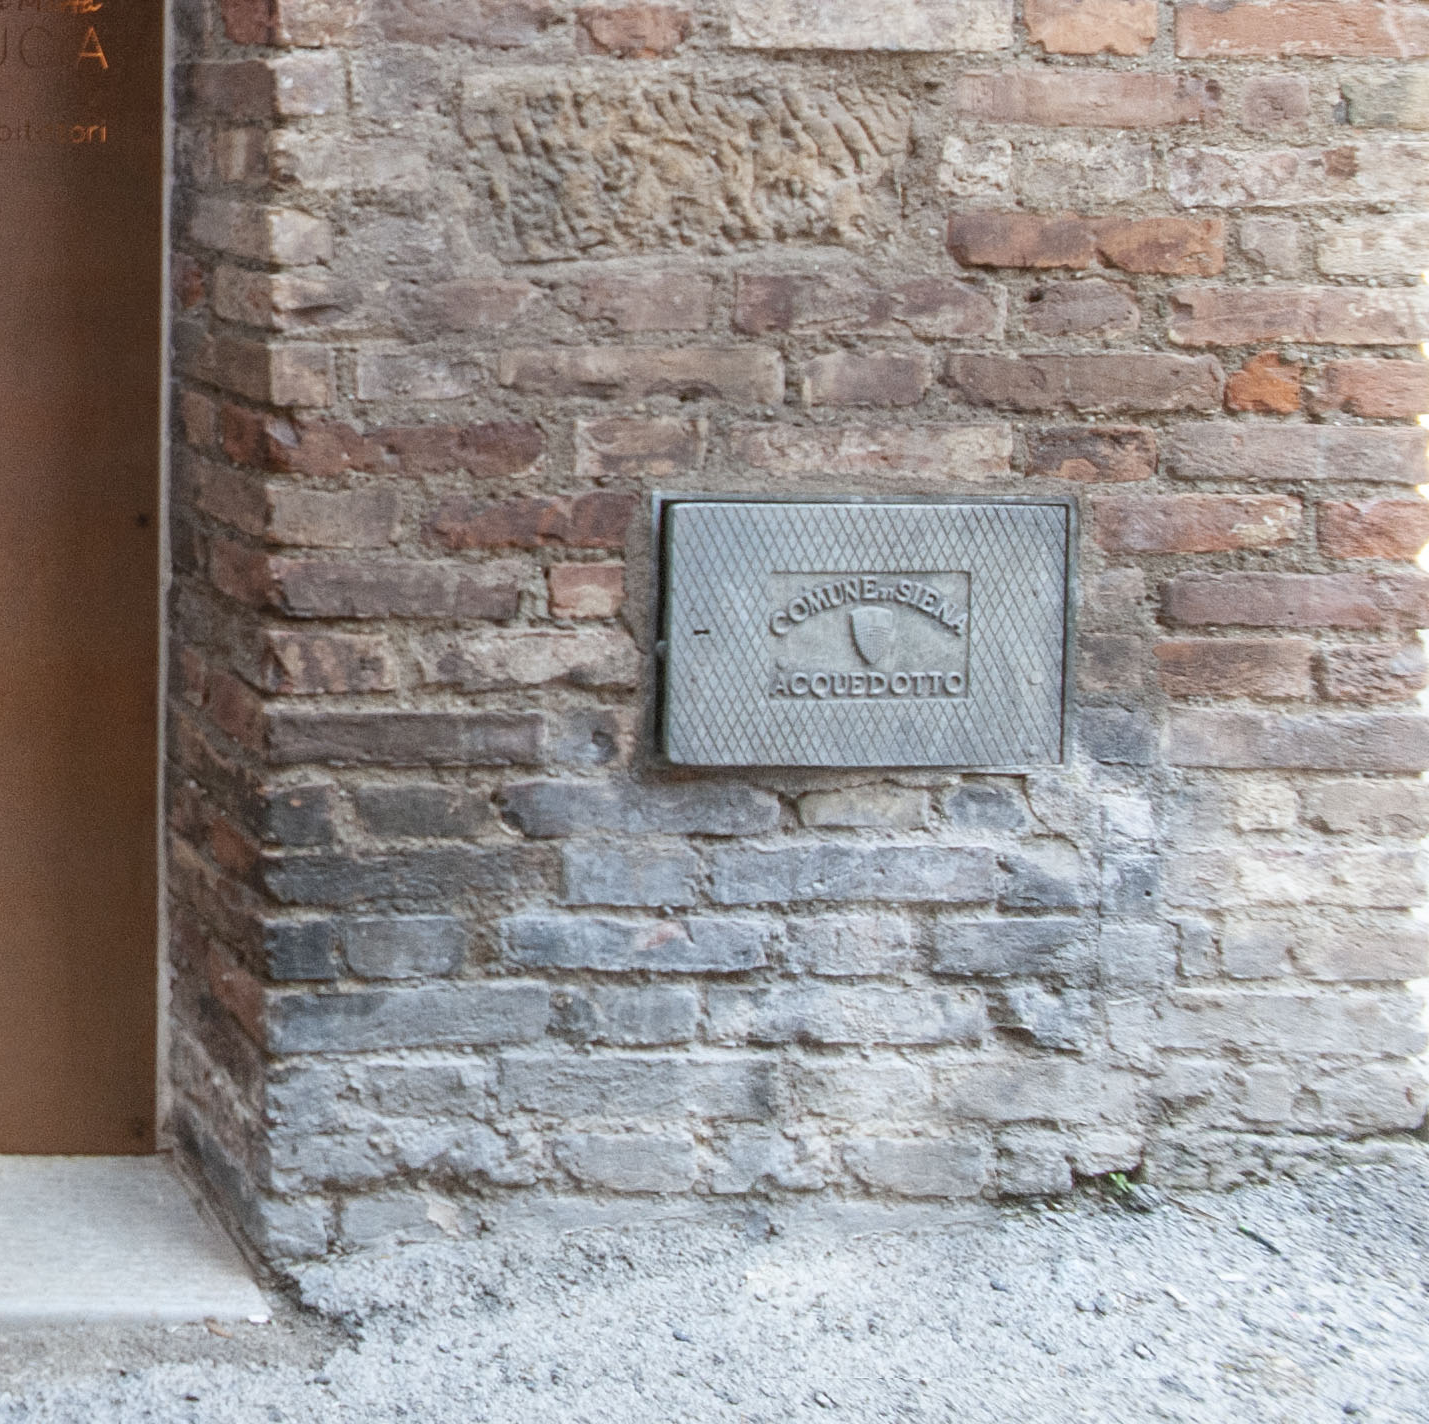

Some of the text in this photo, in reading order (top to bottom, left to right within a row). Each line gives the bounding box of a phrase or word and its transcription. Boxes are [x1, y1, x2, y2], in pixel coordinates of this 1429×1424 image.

[769, 575, 878, 637] COMUNE
[894, 578, 969, 637] SIENA
[768, 671, 966, 699] ACQUEDOTTO
